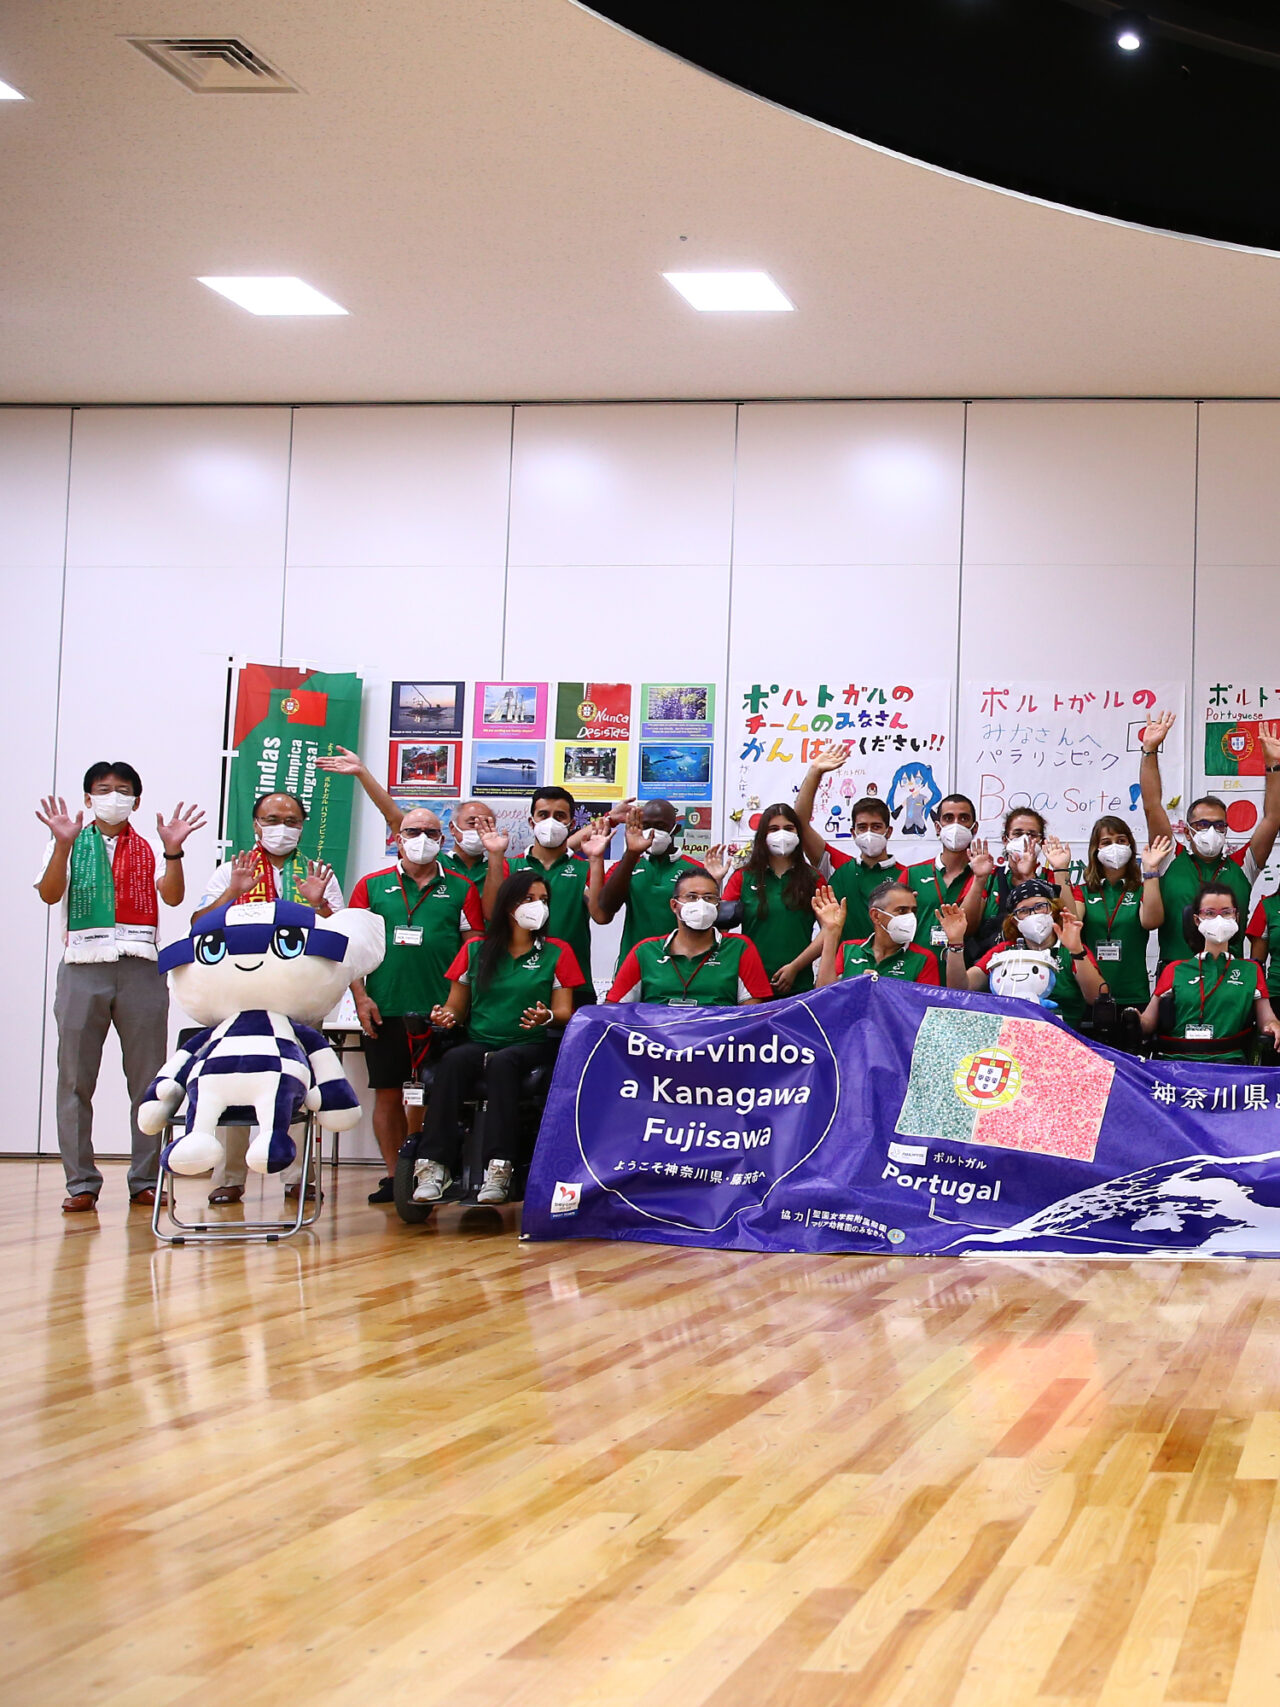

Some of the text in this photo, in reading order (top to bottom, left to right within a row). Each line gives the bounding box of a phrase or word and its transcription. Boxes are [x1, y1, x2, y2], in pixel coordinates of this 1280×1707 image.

[742, 684, 914, 714] ポルトガルの
[980, 687, 1157, 717] ポルトガルの
[594, 707, 630, 724] Nunca
[745, 710, 909, 734] チームのみなさん
[739, 734, 945, 763] がんばてください!!
[982, 723, 1102, 749] みなさんへ
[254, 736, 282, 803] indas
[976, 749, 1120, 771] パラリンピック
[302, 740, 319, 821] ortuguesa!
[978, 774, 1058, 822] Boa
[627, 1031, 816, 1065] Bem-vindos
[619, 1075, 811, 1116] a Kanagawa
[642, 1117, 772, 1152] Fujisawa
[933, 1152, 988, 1170] ポルトガル
[881, 1161, 1002, 1205] Portugal
